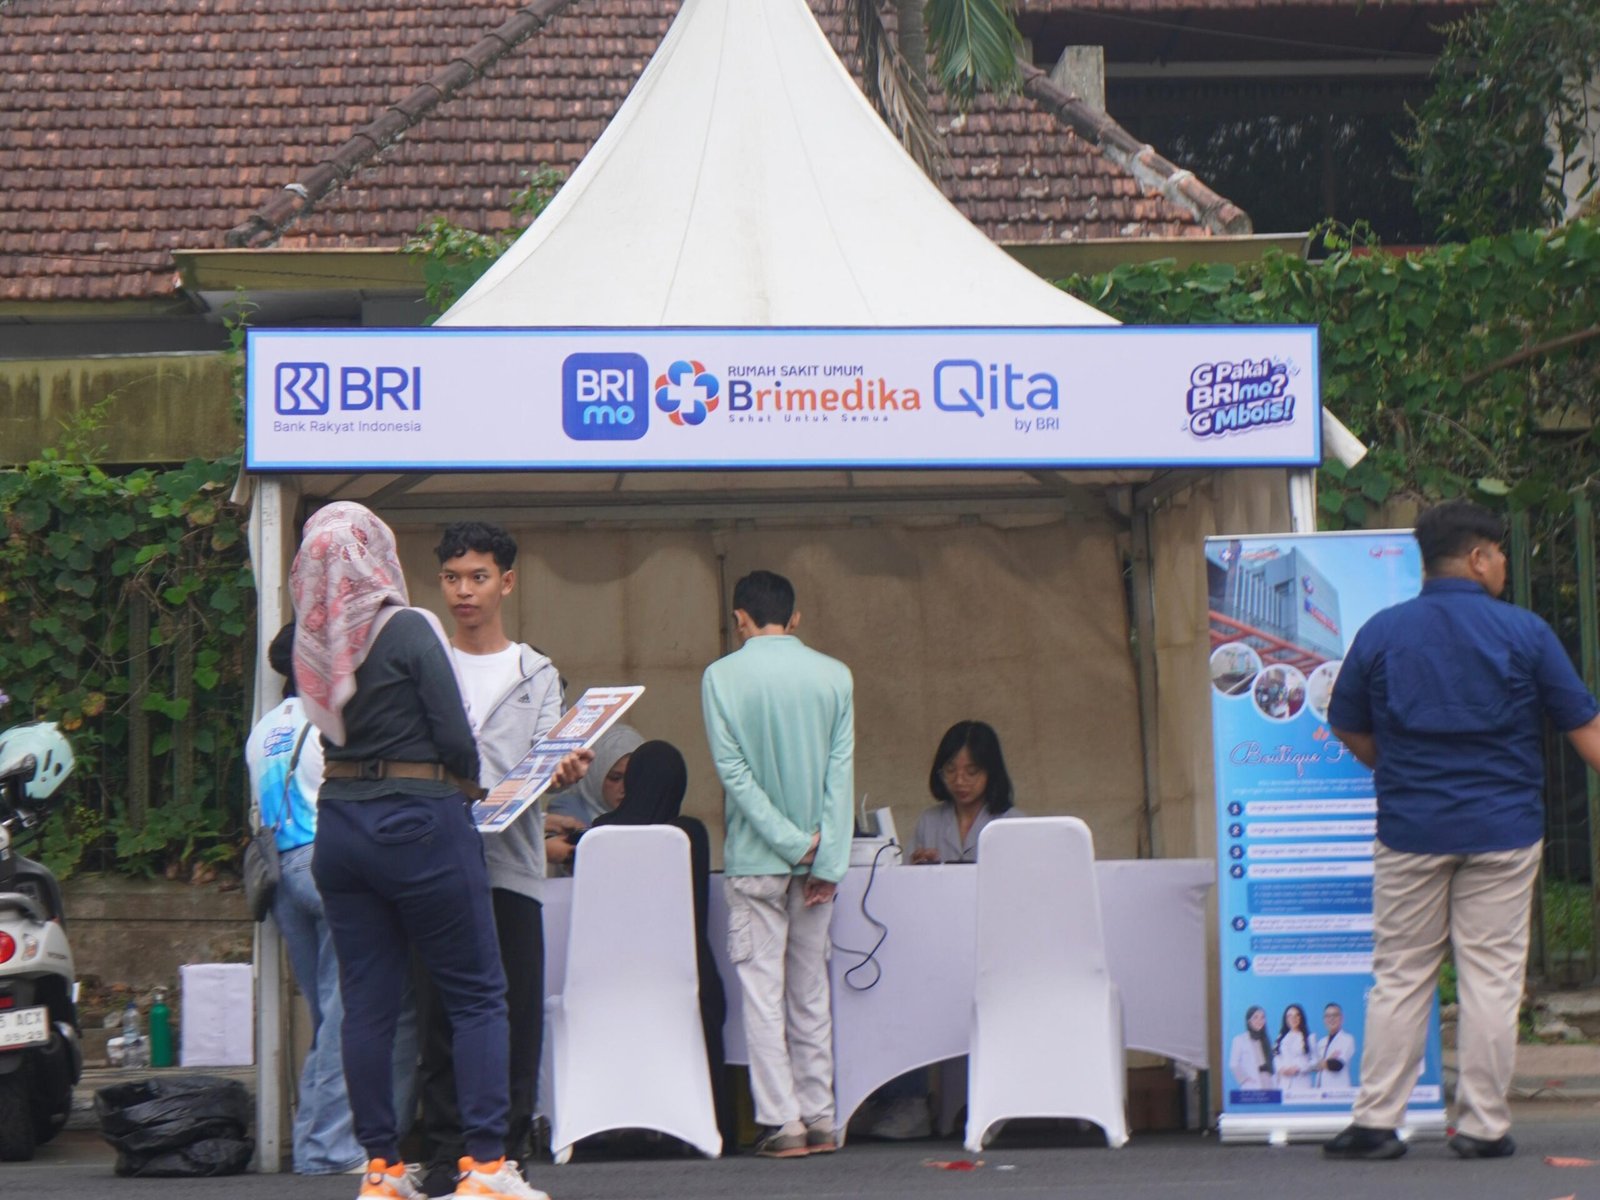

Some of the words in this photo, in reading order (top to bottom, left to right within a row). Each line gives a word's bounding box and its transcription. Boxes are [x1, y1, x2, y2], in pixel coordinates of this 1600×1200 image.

[728, 365, 776, 376] RUMAH
[780, 365, 819, 376] SAKIT
[823, 365, 864, 376] UMUM
[340, 367, 421, 410] BRI
[576, 369, 634, 402] BRI
[728, 377, 921, 411] Brimedika
[933, 359, 1059, 417] Qita
[583, 405, 635, 425] mo
[729, 414, 772, 422] Sehat
[784, 414, 829, 422] Untuk
[841, 414, 889, 422] Semua
[1014, 417, 1032, 433] by
[1036, 417, 1060, 430] BRI
[273, 421, 306, 432] Bank
[310, 421, 354, 434] Rakyat
[358, 421, 422, 432] Indonesia
